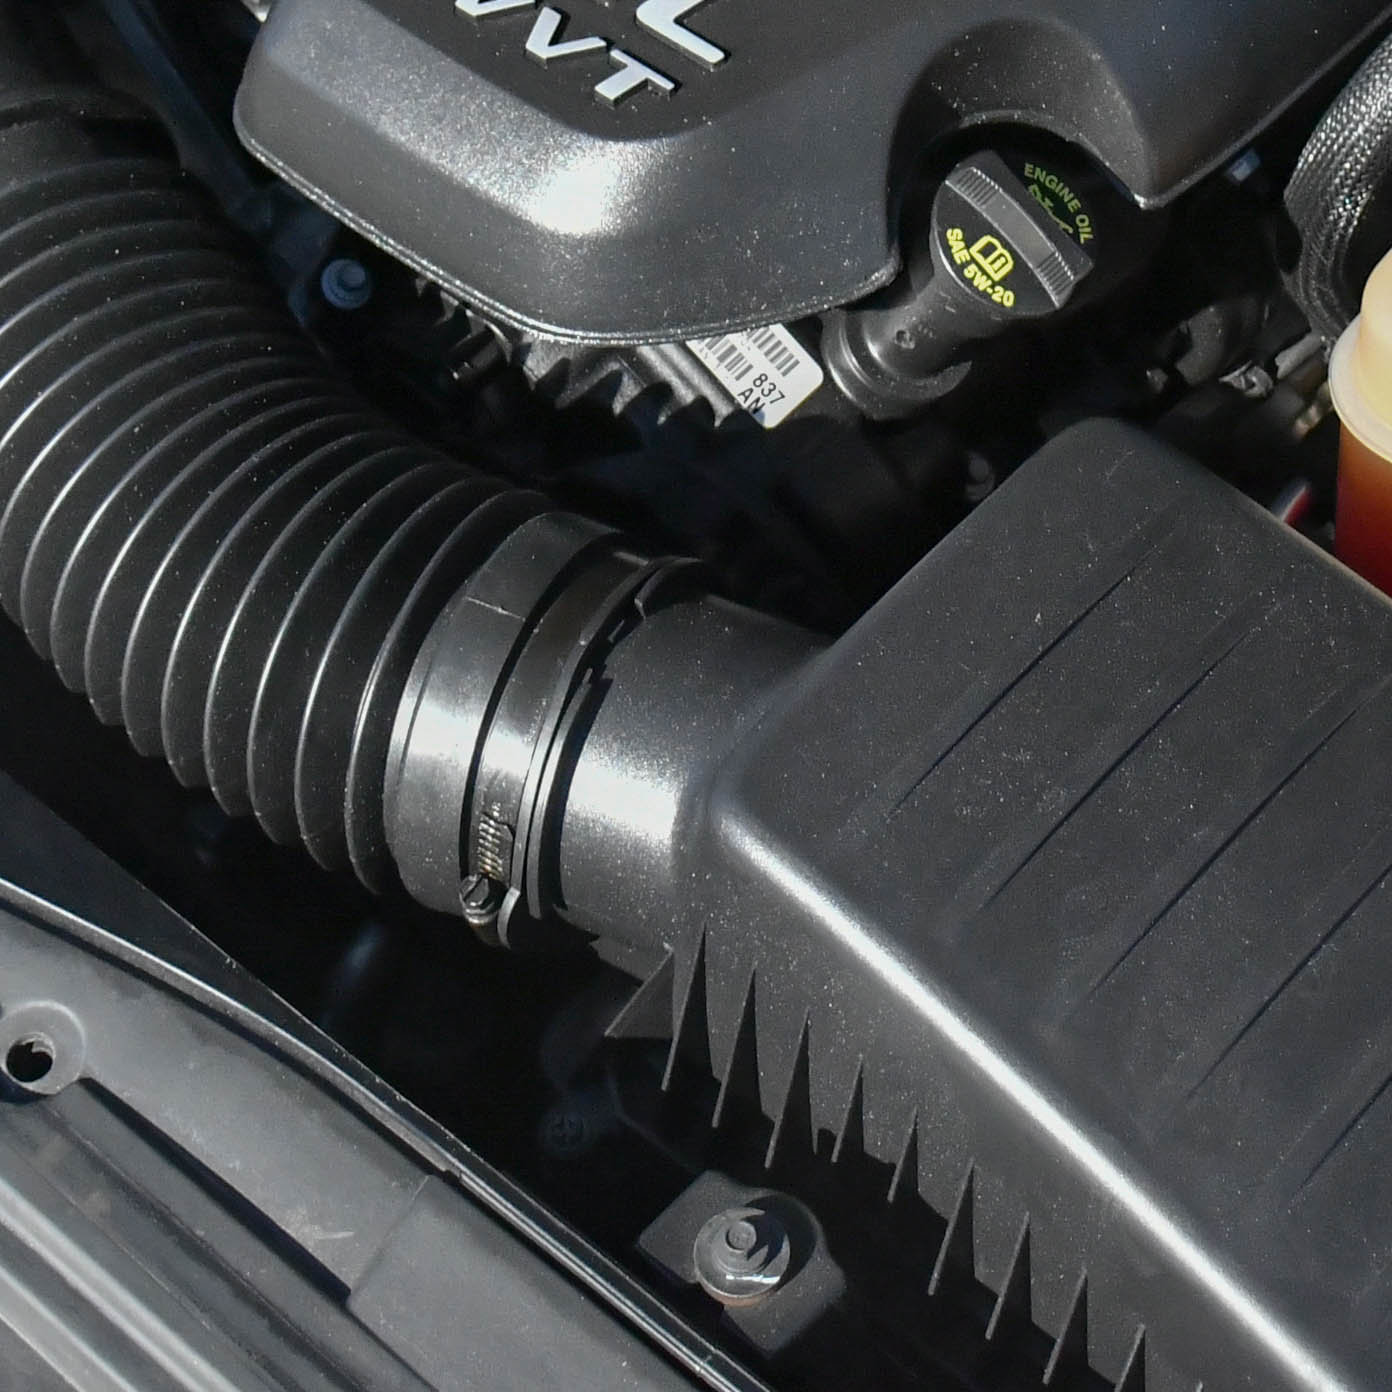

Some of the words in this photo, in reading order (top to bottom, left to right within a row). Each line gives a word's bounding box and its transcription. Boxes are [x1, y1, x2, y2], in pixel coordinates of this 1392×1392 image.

[1024, 162, 1081, 213] ENGINE
[1075, 213, 1095, 244] OIL
[946, 228, 971, 265] SAE
[963, 263, 1015, 308] 5W-20
[753, 373, 786, 404] 837
